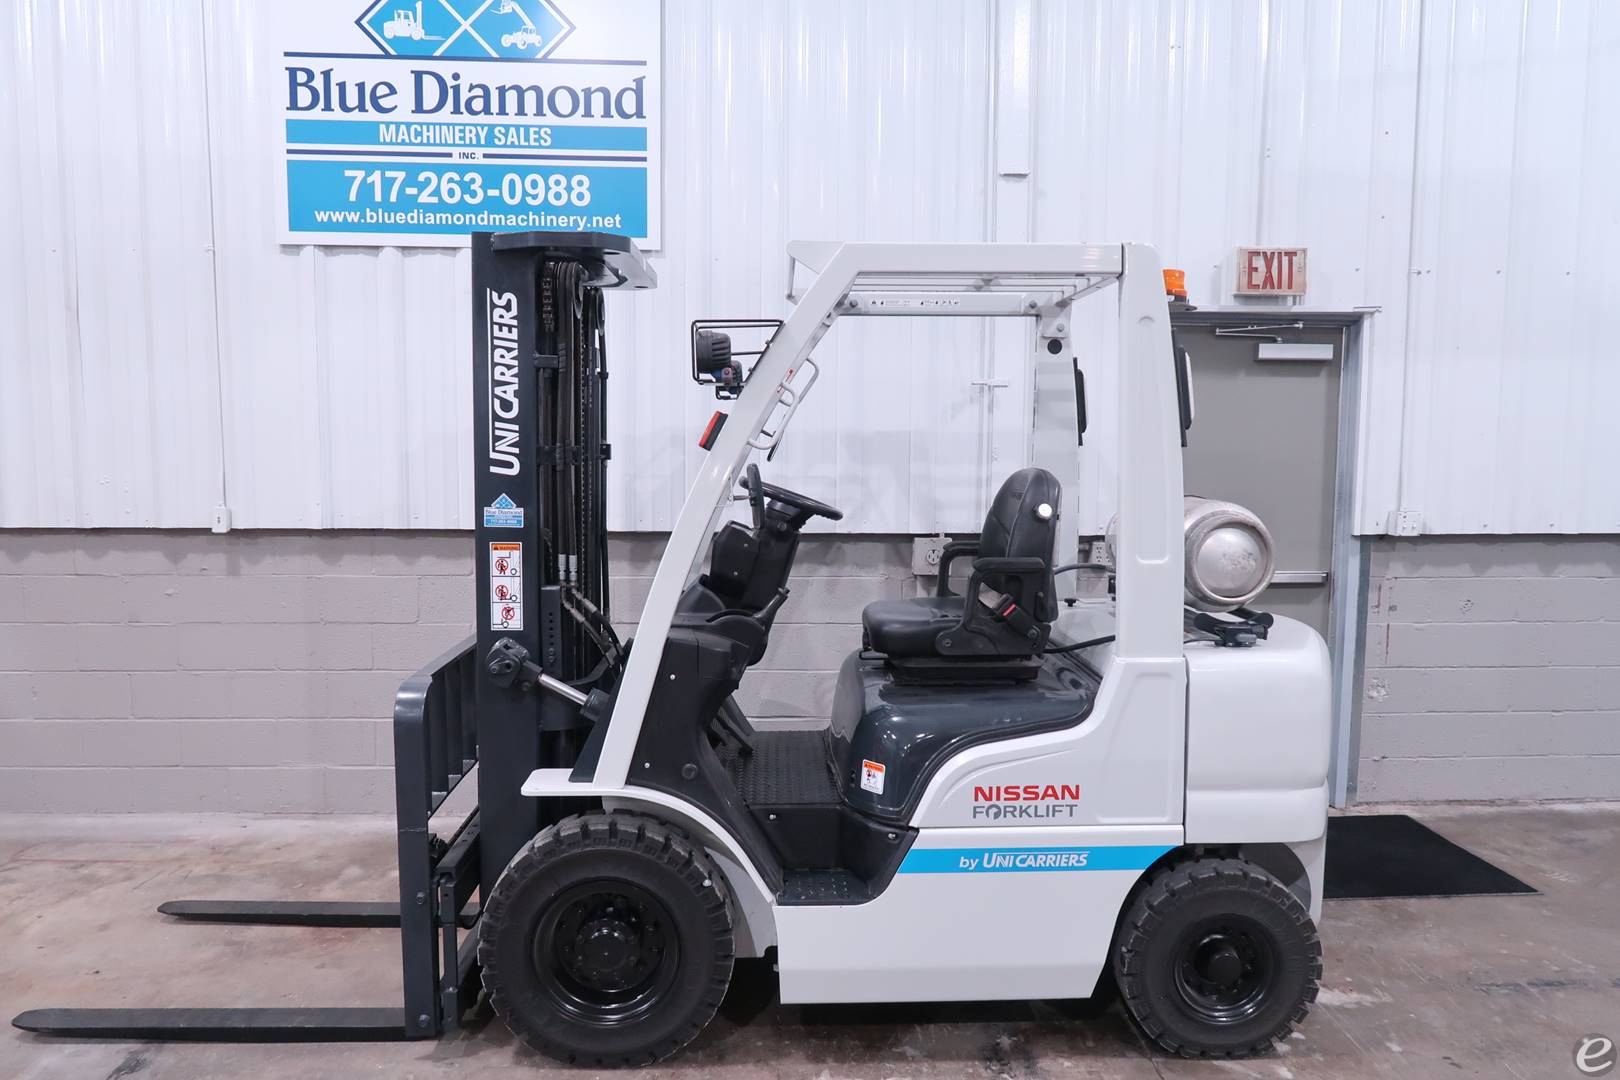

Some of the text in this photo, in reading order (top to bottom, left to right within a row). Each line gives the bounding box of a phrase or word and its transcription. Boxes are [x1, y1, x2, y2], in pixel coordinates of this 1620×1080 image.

[285, 66, 646, 119] Blue Diamond
[379, 124, 552, 147] MACHINERY SALES
[458, 151, 480, 160] INC.
[344, 169, 591, 207] 717-263-0988
[315, 208, 622, 231] www.bluediamondmachinery.net
[1247, 251, 1297, 290] EXIT
[974, 784, 1080, 802] NISSAN
[972, 804, 1078, 820] FORKLIFT
[959, 856, 979, 870] by
